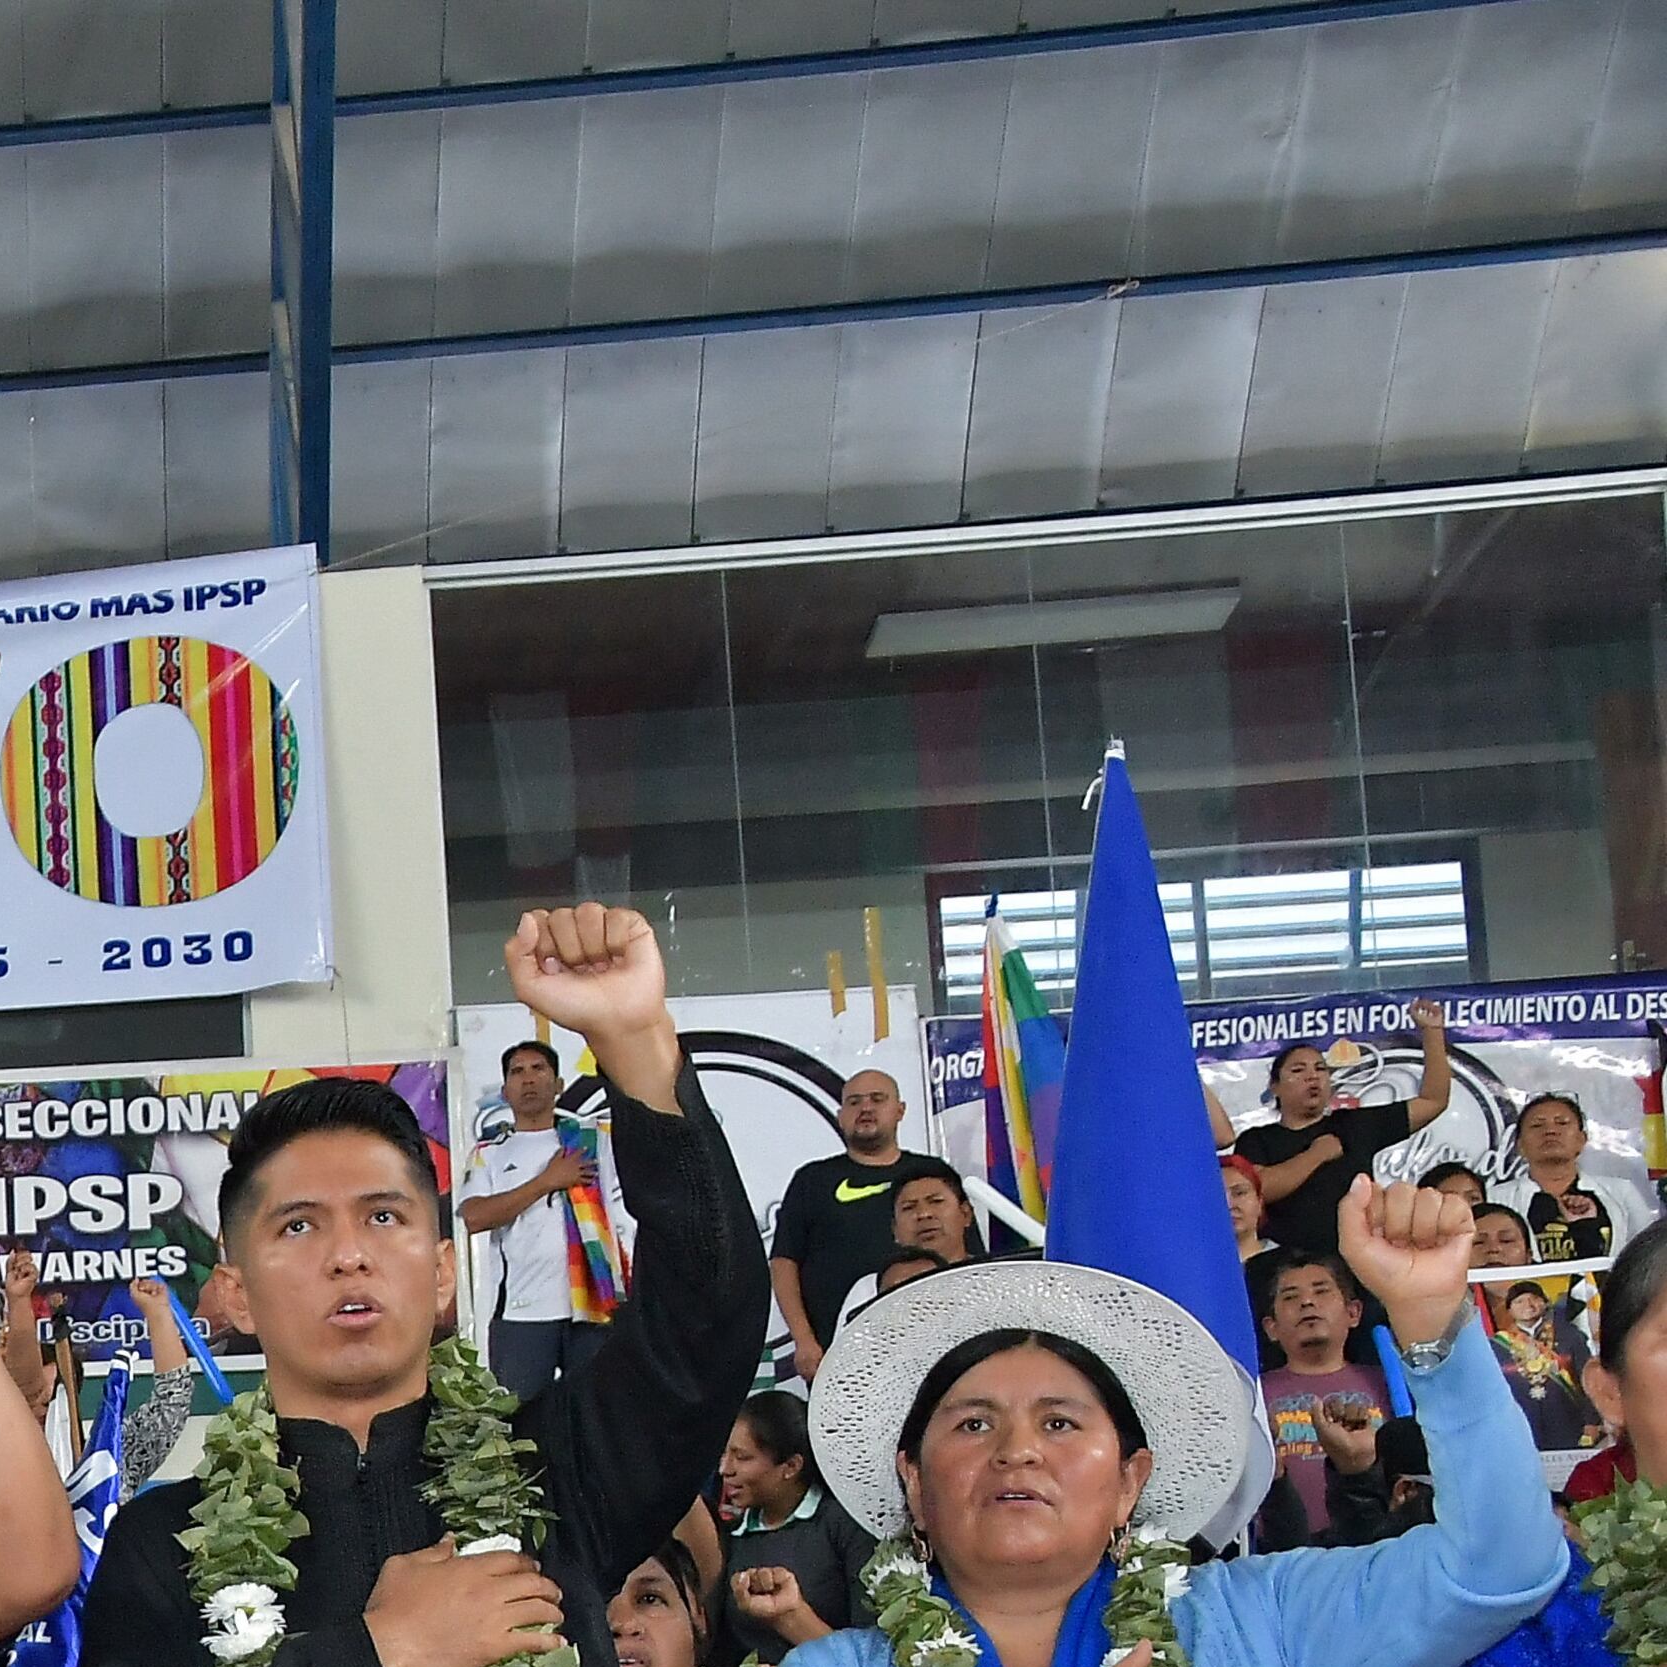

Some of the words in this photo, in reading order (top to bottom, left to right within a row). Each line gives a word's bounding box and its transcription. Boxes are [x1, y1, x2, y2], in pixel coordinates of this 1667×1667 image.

[89, 588, 174, 618] MAS
[182, 578, 267, 612] IPSP
[101, 930, 253, 972] 2030
[1191, 1009, 1329, 1048] FESIONALES
[1333, 1005, 1364, 1035] EN
[1591, 996, 1623, 1022] AL
